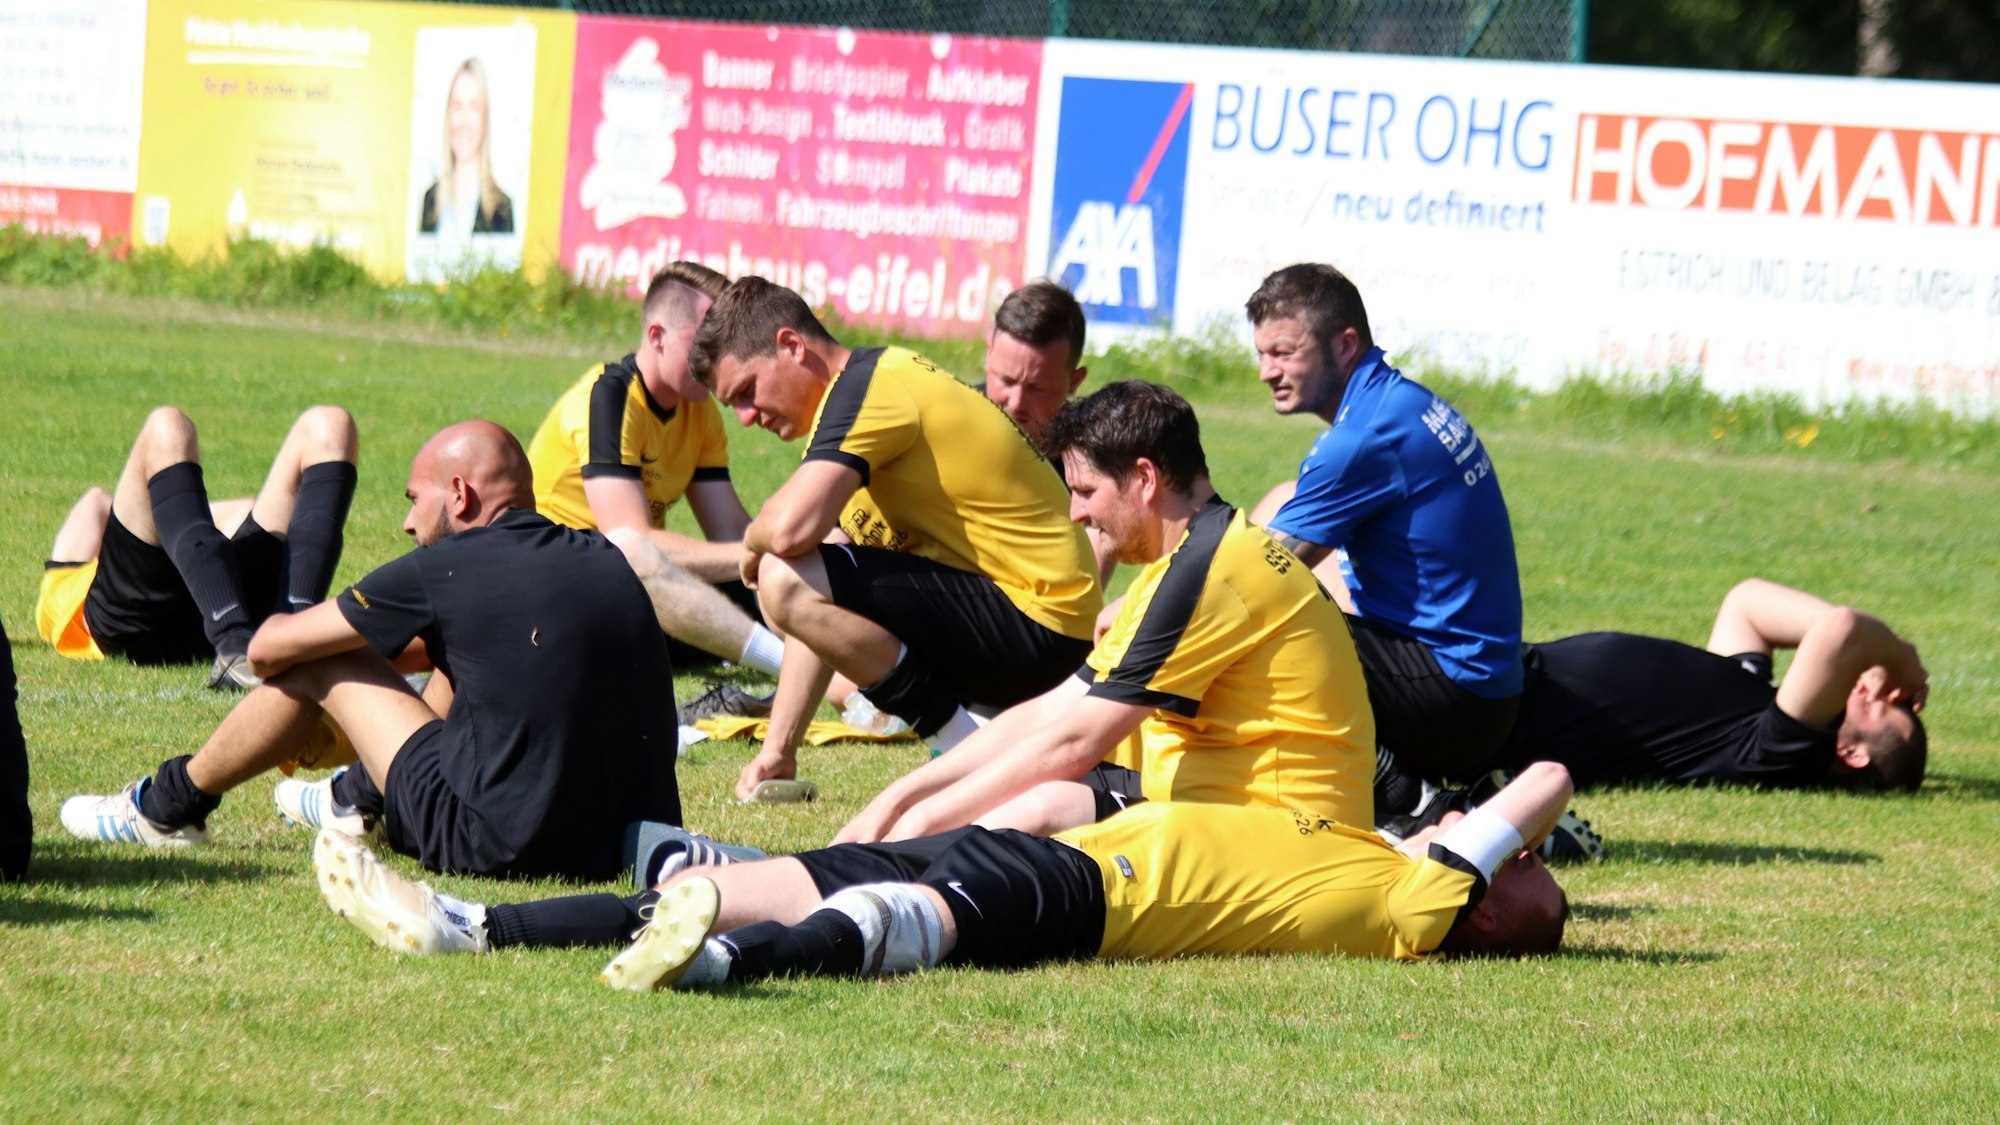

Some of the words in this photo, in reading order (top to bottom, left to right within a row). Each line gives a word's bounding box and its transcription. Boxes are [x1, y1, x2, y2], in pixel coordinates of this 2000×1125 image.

[702, 51, 775, 90] Banner
[790, 54, 909, 103] Briefpapier
[926, 64, 1029, 107] Aufkleber
[702, 98, 812, 142] Web-Design
[831, 104, 947, 147] Textildruck
[963, 112, 1026, 152] Grafik
[1211, 66, 1397, 162] BÜSER
[1415, 94, 1556, 171] OHG
[699, 139, 780, 180] Schilder
[944, 157, 1023, 199] Plakate
[776, 190, 1019, 245] Fahrzeugbeschriftungen
[1332, 188, 1393, 224] neu
[1403, 186, 1546, 234] definiert
[1050, 200, 1158, 309] AXA
[1617, 247, 1725, 294] ESTRICH
[1736, 254, 1790, 300] UND
